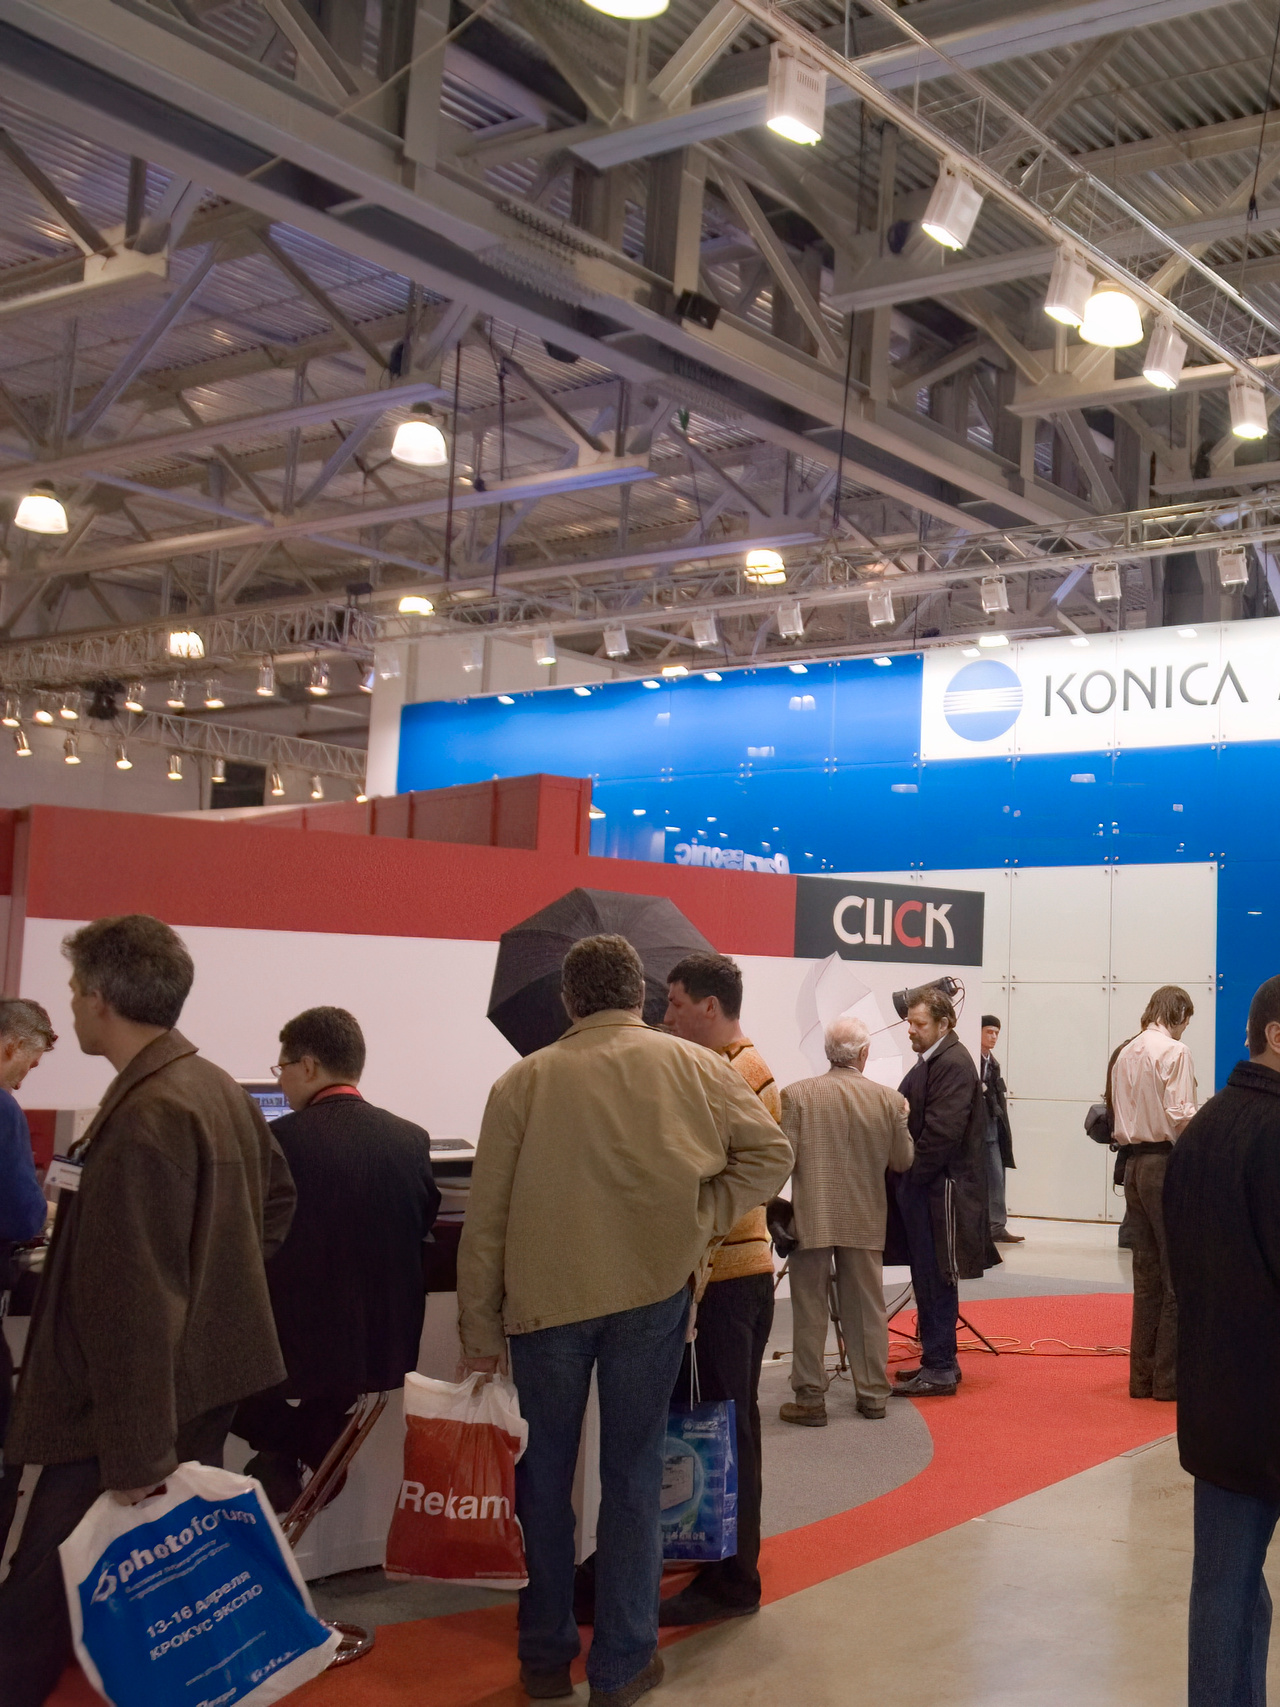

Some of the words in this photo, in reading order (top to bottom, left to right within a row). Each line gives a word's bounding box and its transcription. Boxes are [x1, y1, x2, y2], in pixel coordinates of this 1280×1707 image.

[1045, 660, 1249, 717] KONICA
[832, 895, 955, 949] CLICK
[398, 1480, 511, 1520] Rekam
[118, 1508, 258, 1584] photoforum
[146, 1605, 194, 1639] 13-16
[149, 1618, 214, 1662] КРОКУС
[213, 1584, 264, 1624] ЭКСПО
